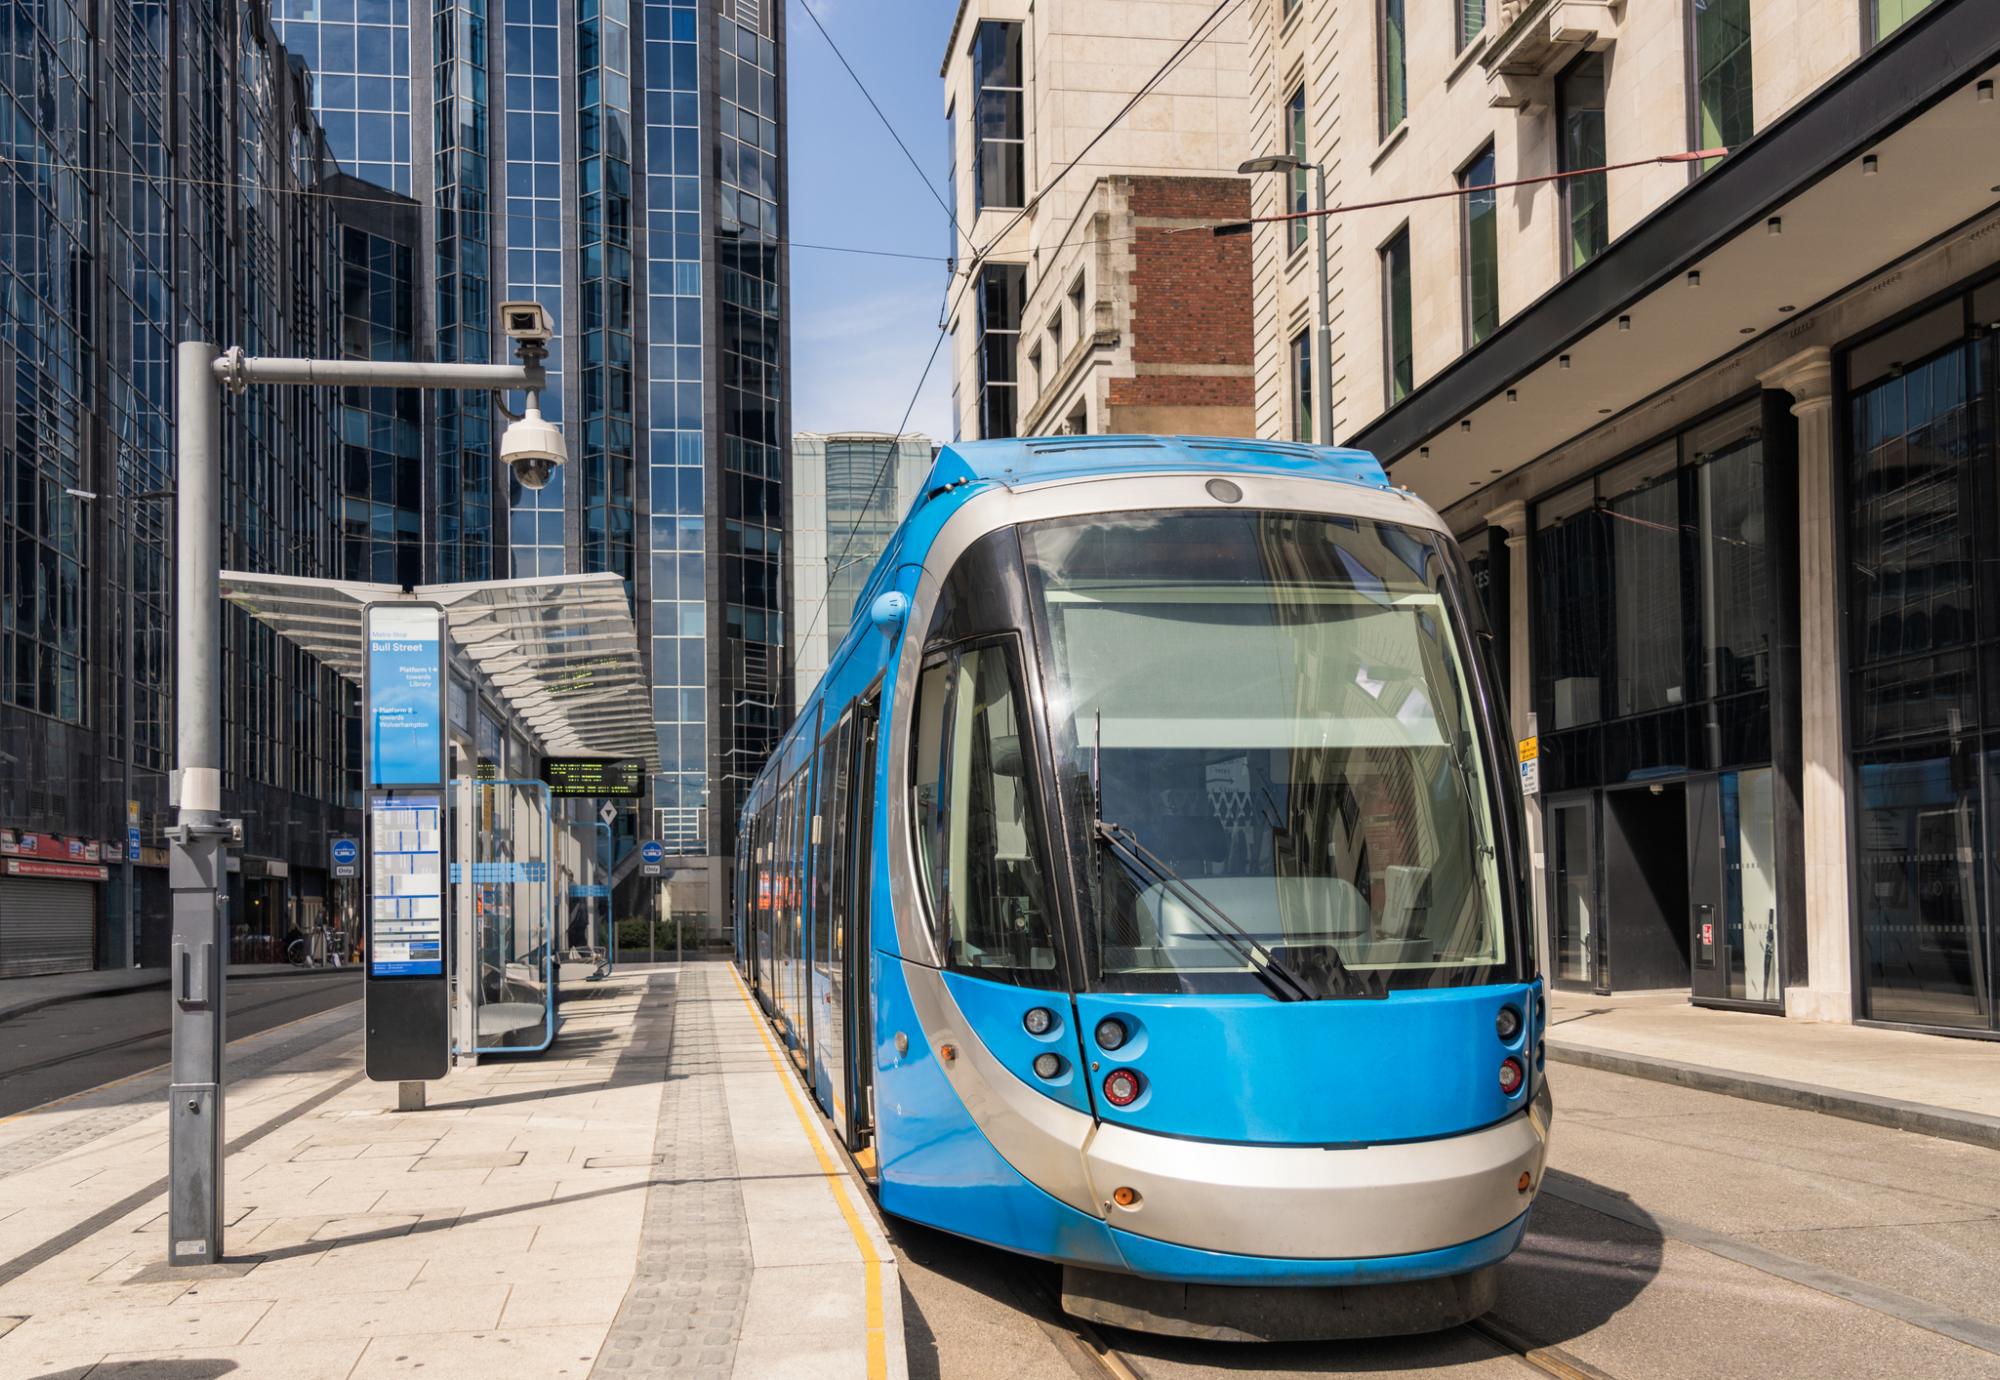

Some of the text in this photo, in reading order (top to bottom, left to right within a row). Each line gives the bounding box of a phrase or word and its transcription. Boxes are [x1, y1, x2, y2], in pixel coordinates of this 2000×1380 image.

[372, 642, 423, 652] Bull Street
[409, 680, 432, 688] Library
